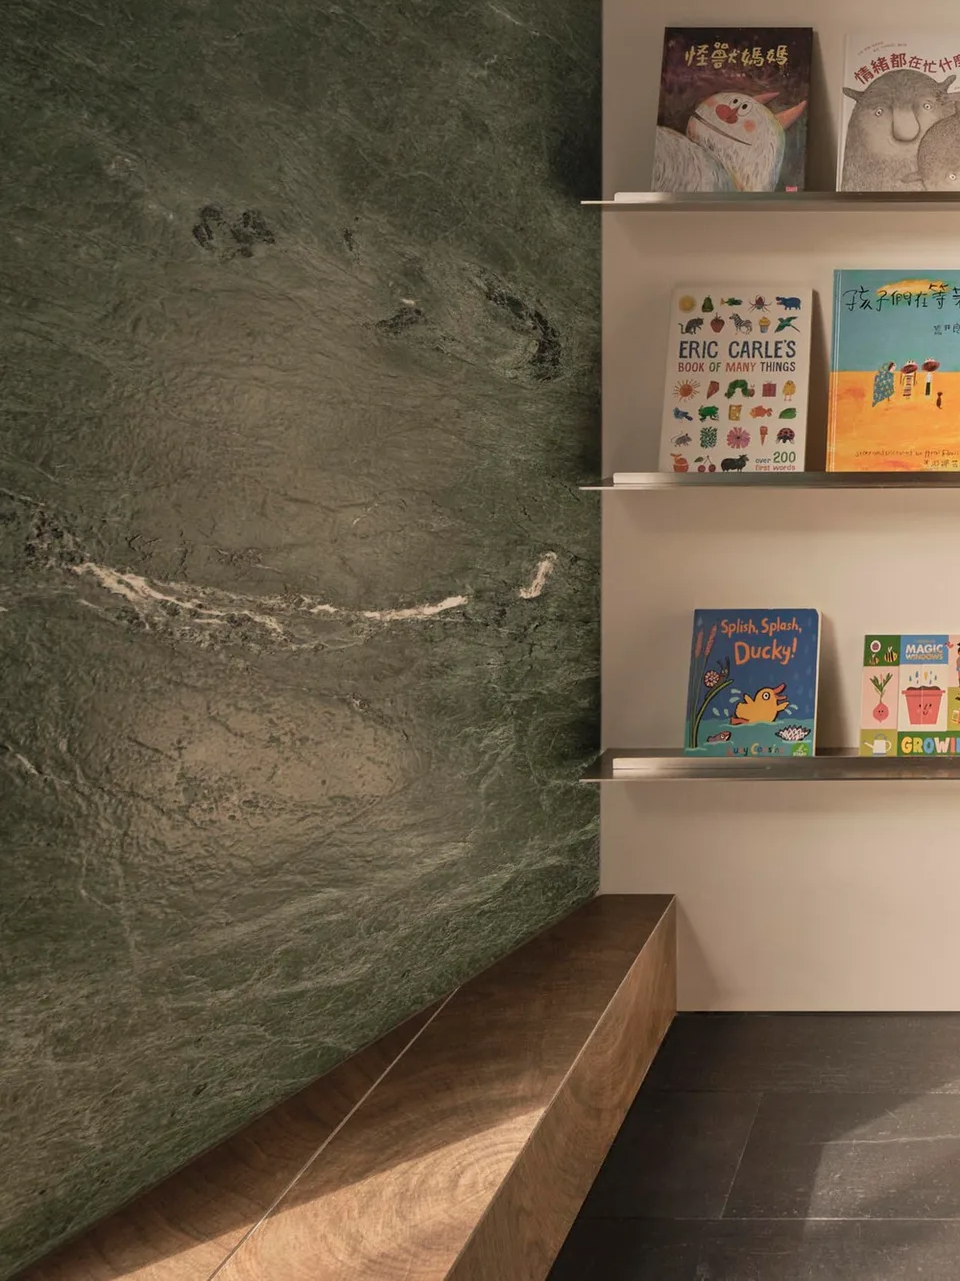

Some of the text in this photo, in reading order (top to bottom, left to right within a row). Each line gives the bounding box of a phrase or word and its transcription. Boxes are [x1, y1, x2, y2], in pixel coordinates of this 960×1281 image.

[685, 42, 788, 69] 怪獸媽媽
[678, 339, 797, 359] ERIC CARLE'S
[678, 361, 796, 372] BOOK OF MANY THINGS
[773, 451, 797, 463] 200
[721, 616, 802, 638] Splish, Splash,
[735, 637, 797, 665] Ducky!
[905, 644, 944, 653] MAGIC
